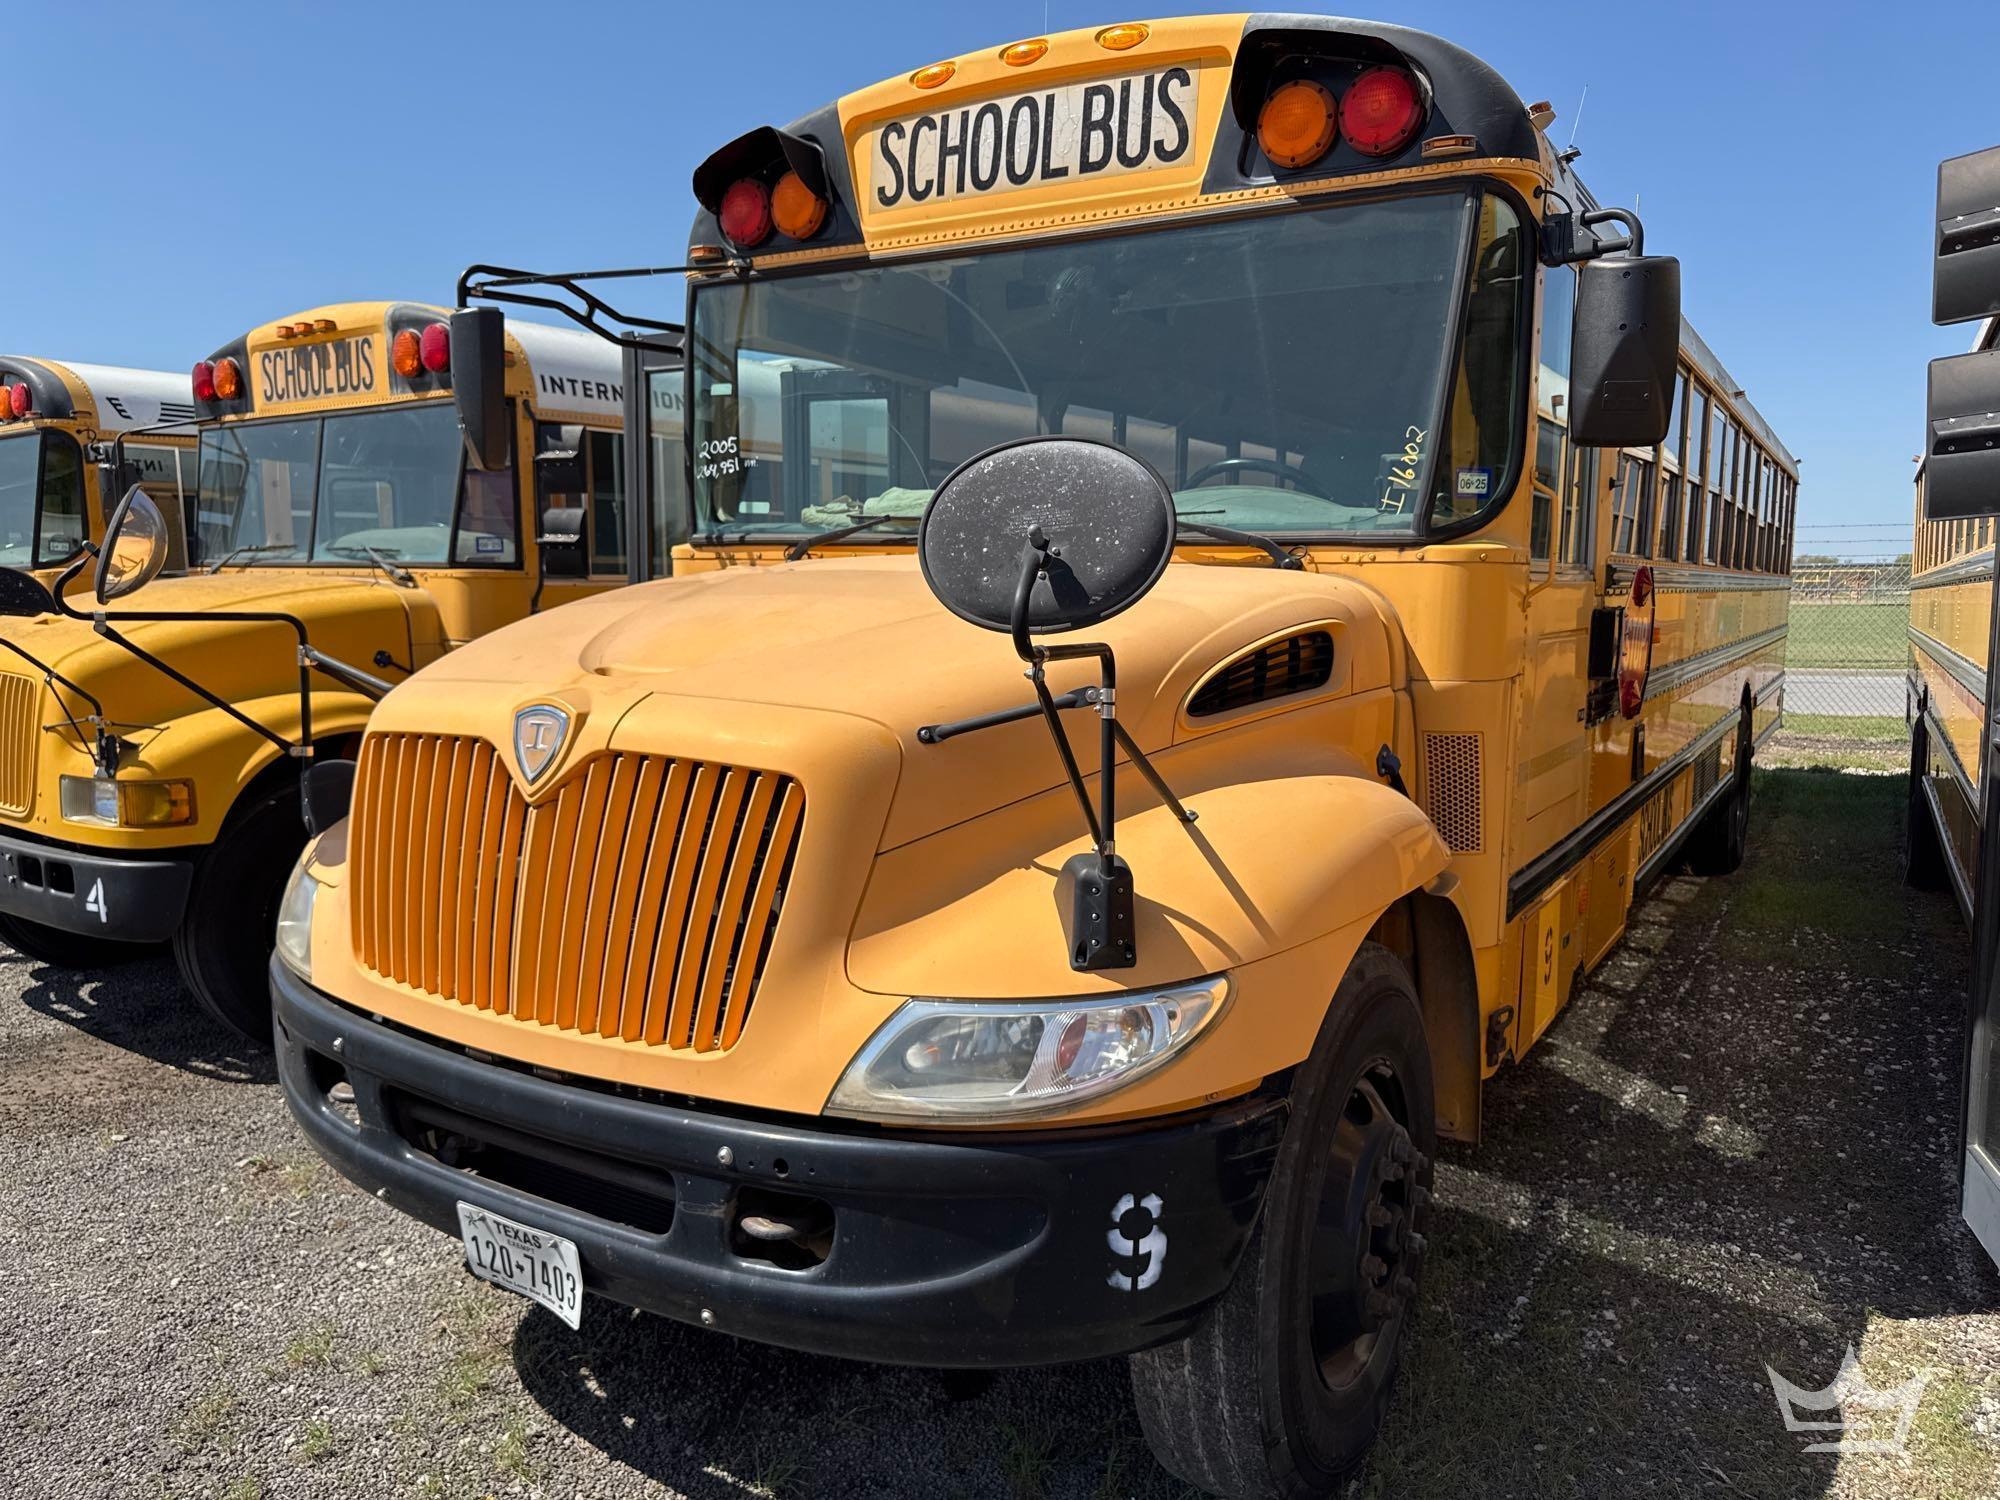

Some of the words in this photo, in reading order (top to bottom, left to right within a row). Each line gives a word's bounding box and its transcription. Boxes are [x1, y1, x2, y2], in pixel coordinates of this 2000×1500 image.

[876, 93, 1069, 209] SCHOOL
[1078, 67, 1192, 174] BUS
[262, 342, 334, 403] SCHOOL
[334, 337, 374, 393] BUS
[699, 436, 737, 459] 2005
[85, 877, 108, 923] 4
[493, 1220, 542, 1249] TEXAS
[1106, 1191, 1168, 1291] 9
